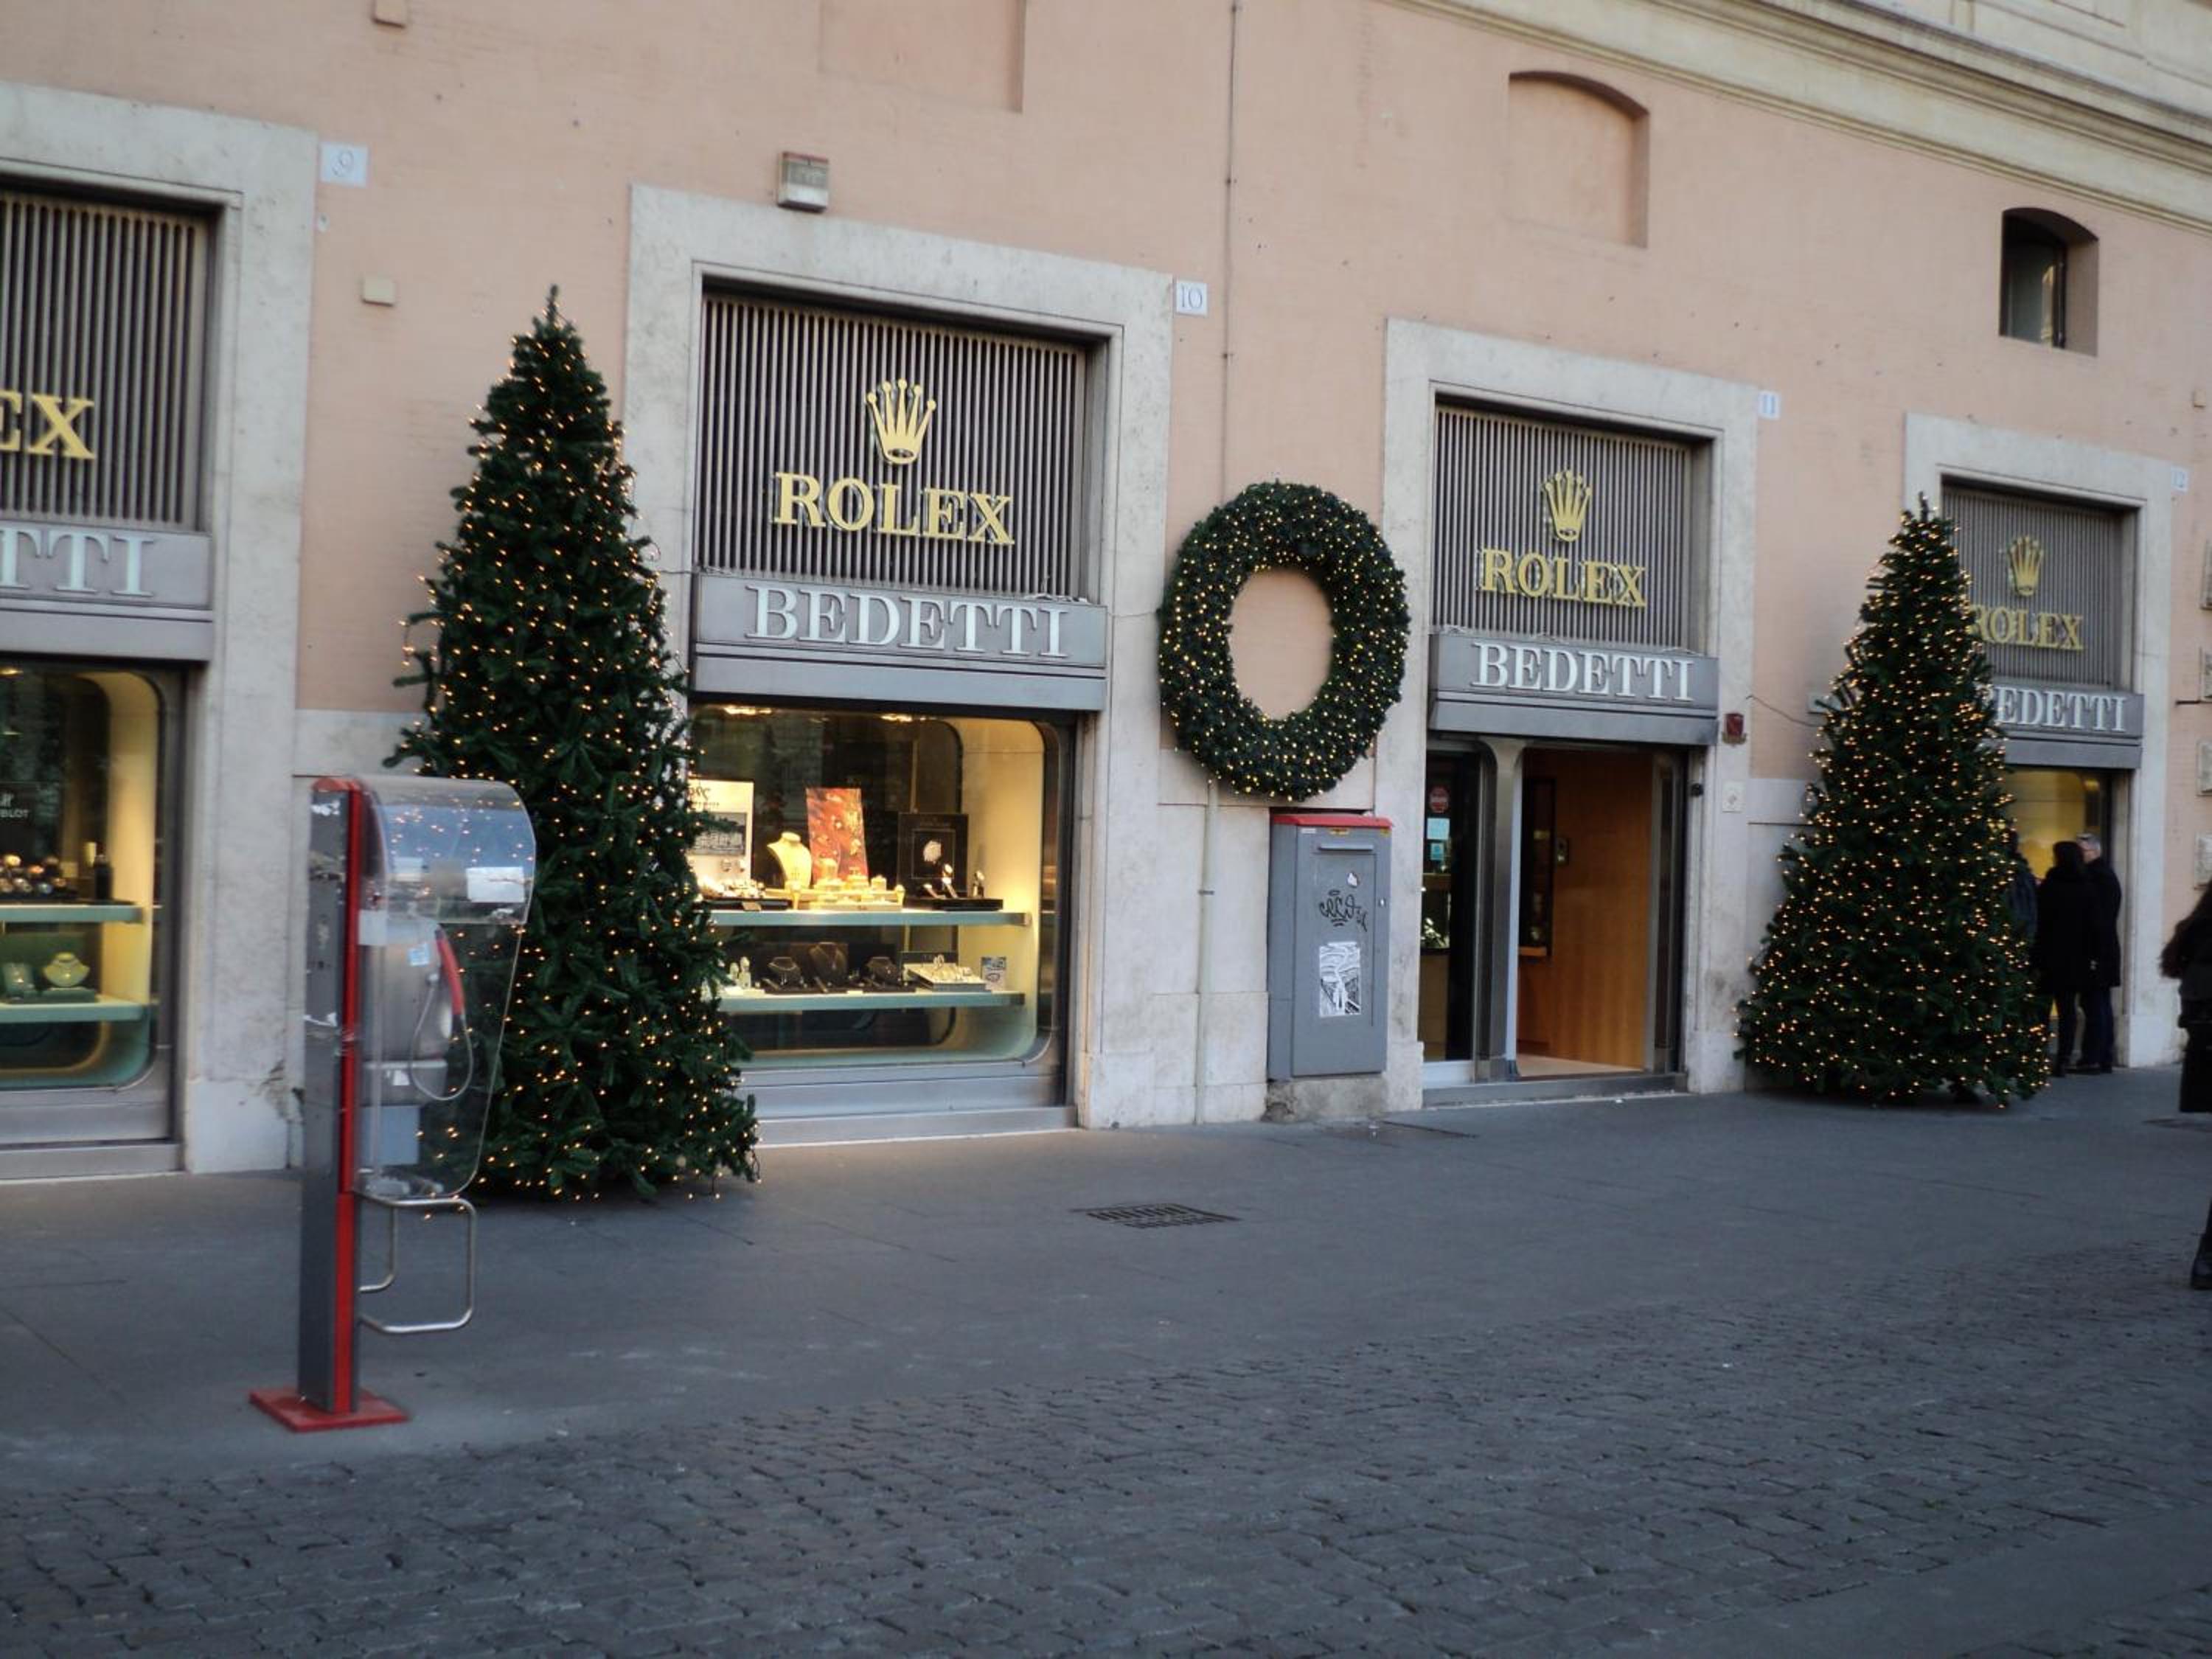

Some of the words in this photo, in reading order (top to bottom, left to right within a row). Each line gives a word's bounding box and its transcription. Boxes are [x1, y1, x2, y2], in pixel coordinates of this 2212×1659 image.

[1180, 284, 1203, 310] 10
[771, 471, 1015, 546] ROLEX
[1475, 546, 1647, 608] ROLEX
[744, 585, 1069, 658] BEDETTI
[1470, 641, 1695, 702] BEDETTI
[1988, 684, 2127, 732] EDETTI
